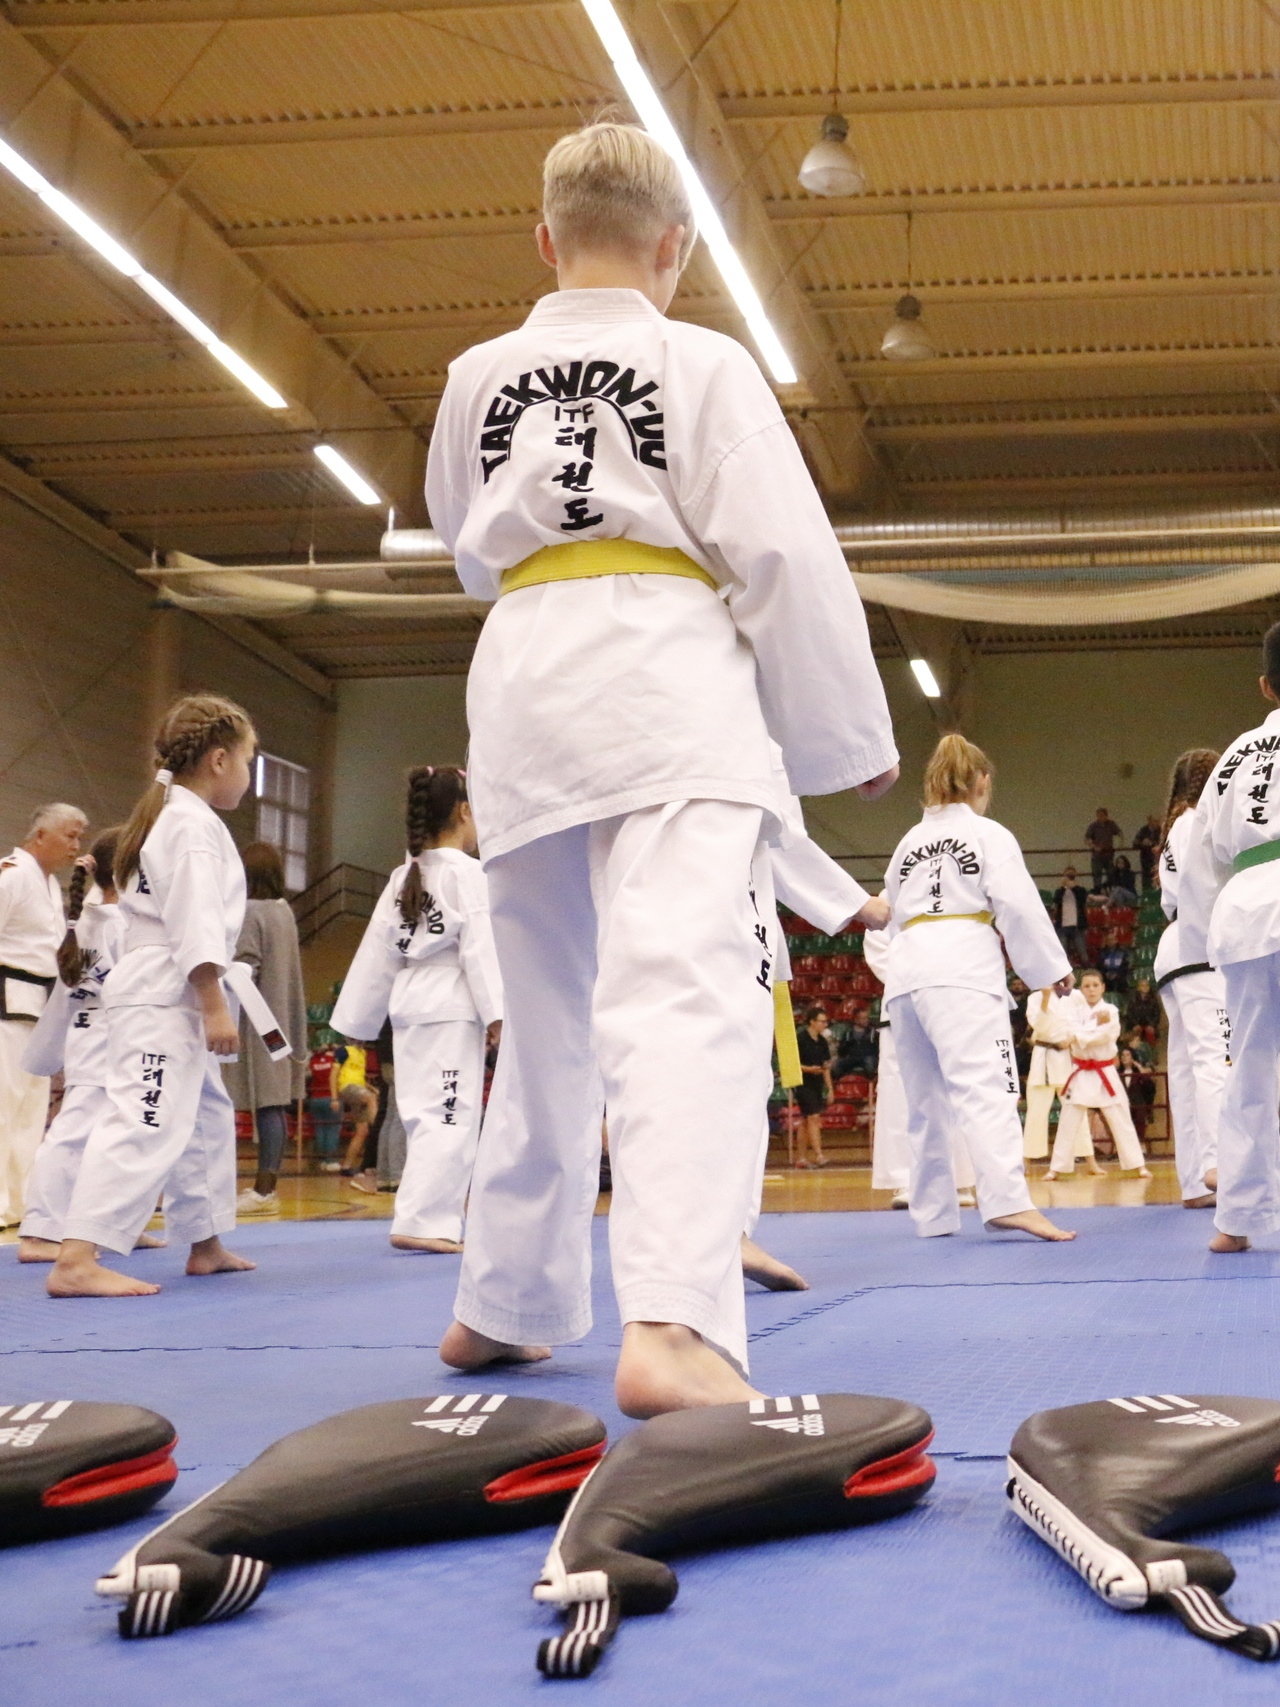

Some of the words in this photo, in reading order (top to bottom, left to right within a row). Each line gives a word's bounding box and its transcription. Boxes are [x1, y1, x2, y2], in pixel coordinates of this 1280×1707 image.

[554, 402, 594, 423] ITF
[142, 1053, 167, 1066] ITF
[442, 1070, 460, 1079] ITF
